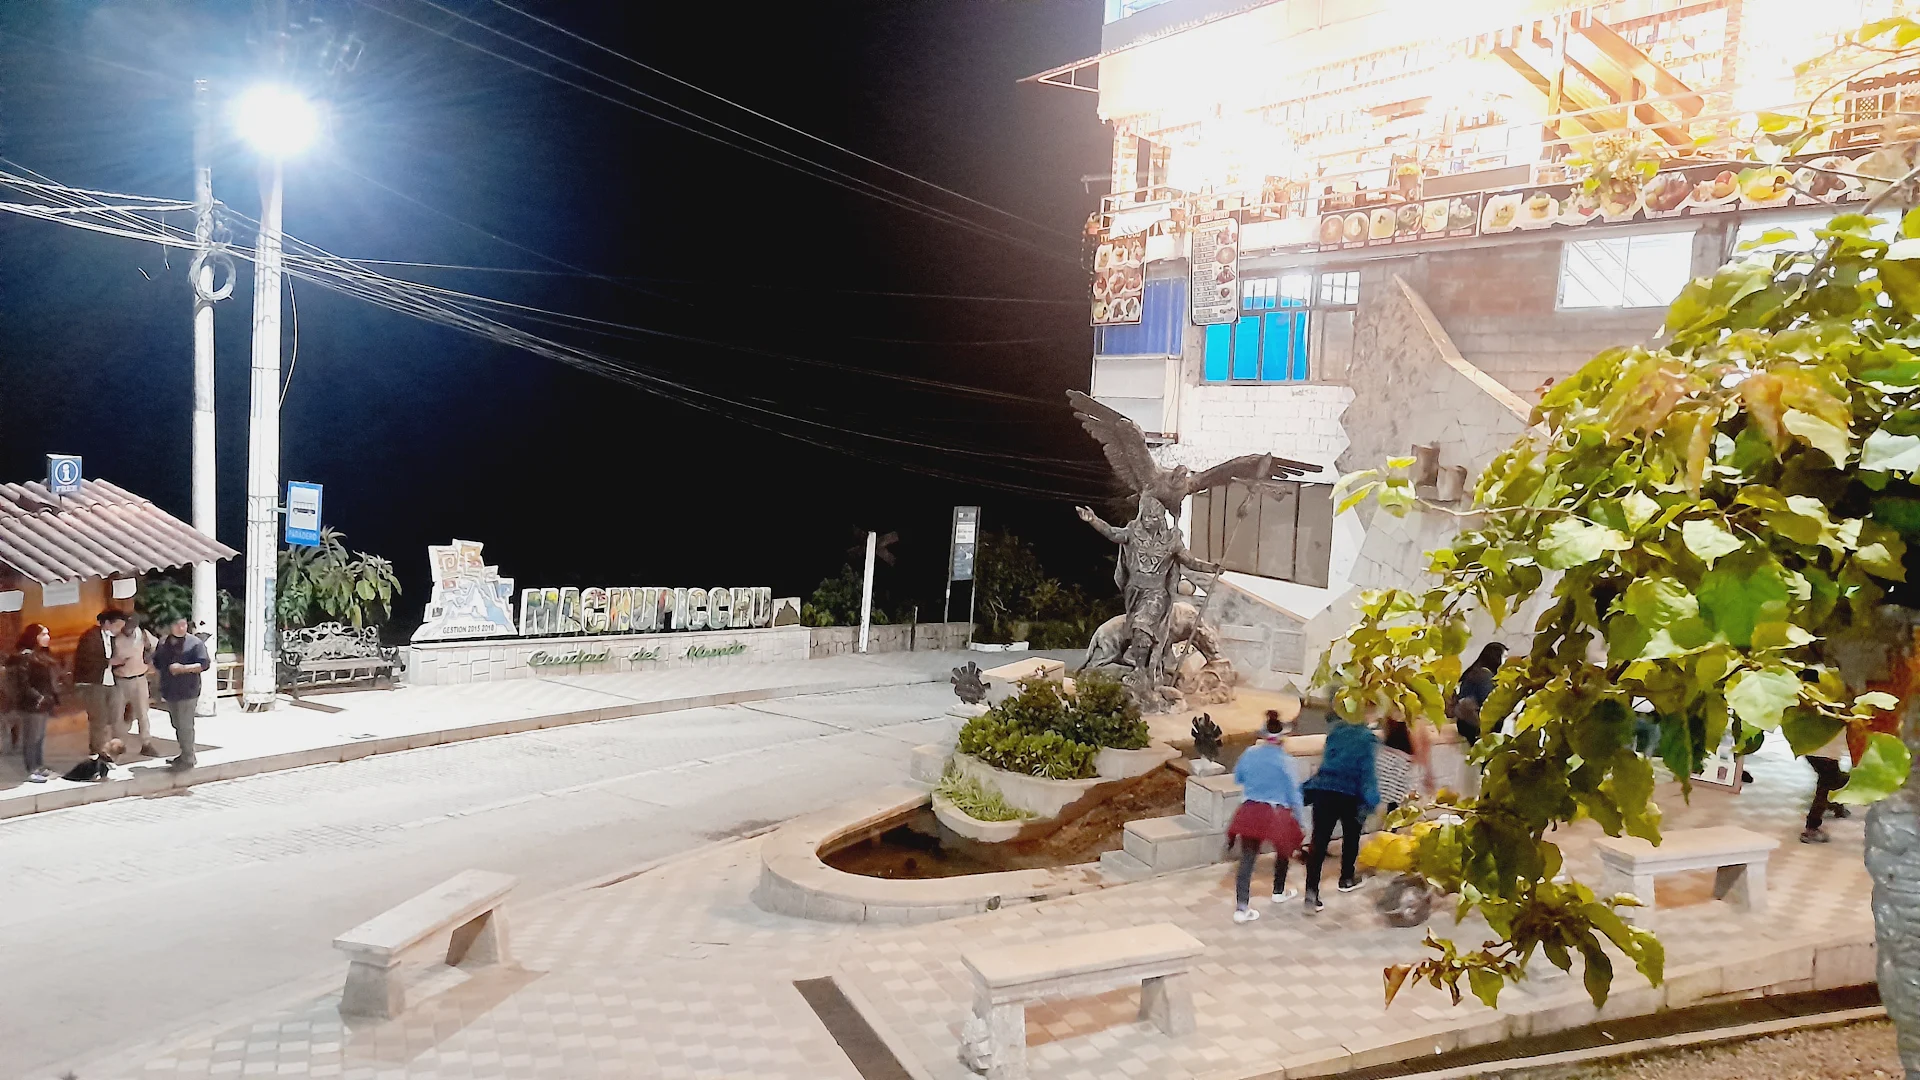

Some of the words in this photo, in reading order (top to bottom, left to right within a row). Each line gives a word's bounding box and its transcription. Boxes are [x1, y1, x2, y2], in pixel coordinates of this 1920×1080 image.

[519, 587, 772, 636] MACHUPICCHU
[442, 626, 467, 634] GESTION
[467, 625, 480, 633] 2015
[527, 648, 611, 666] Ciudad
[627, 645, 662, 661] del
[679, 639, 747, 659] Mundo
